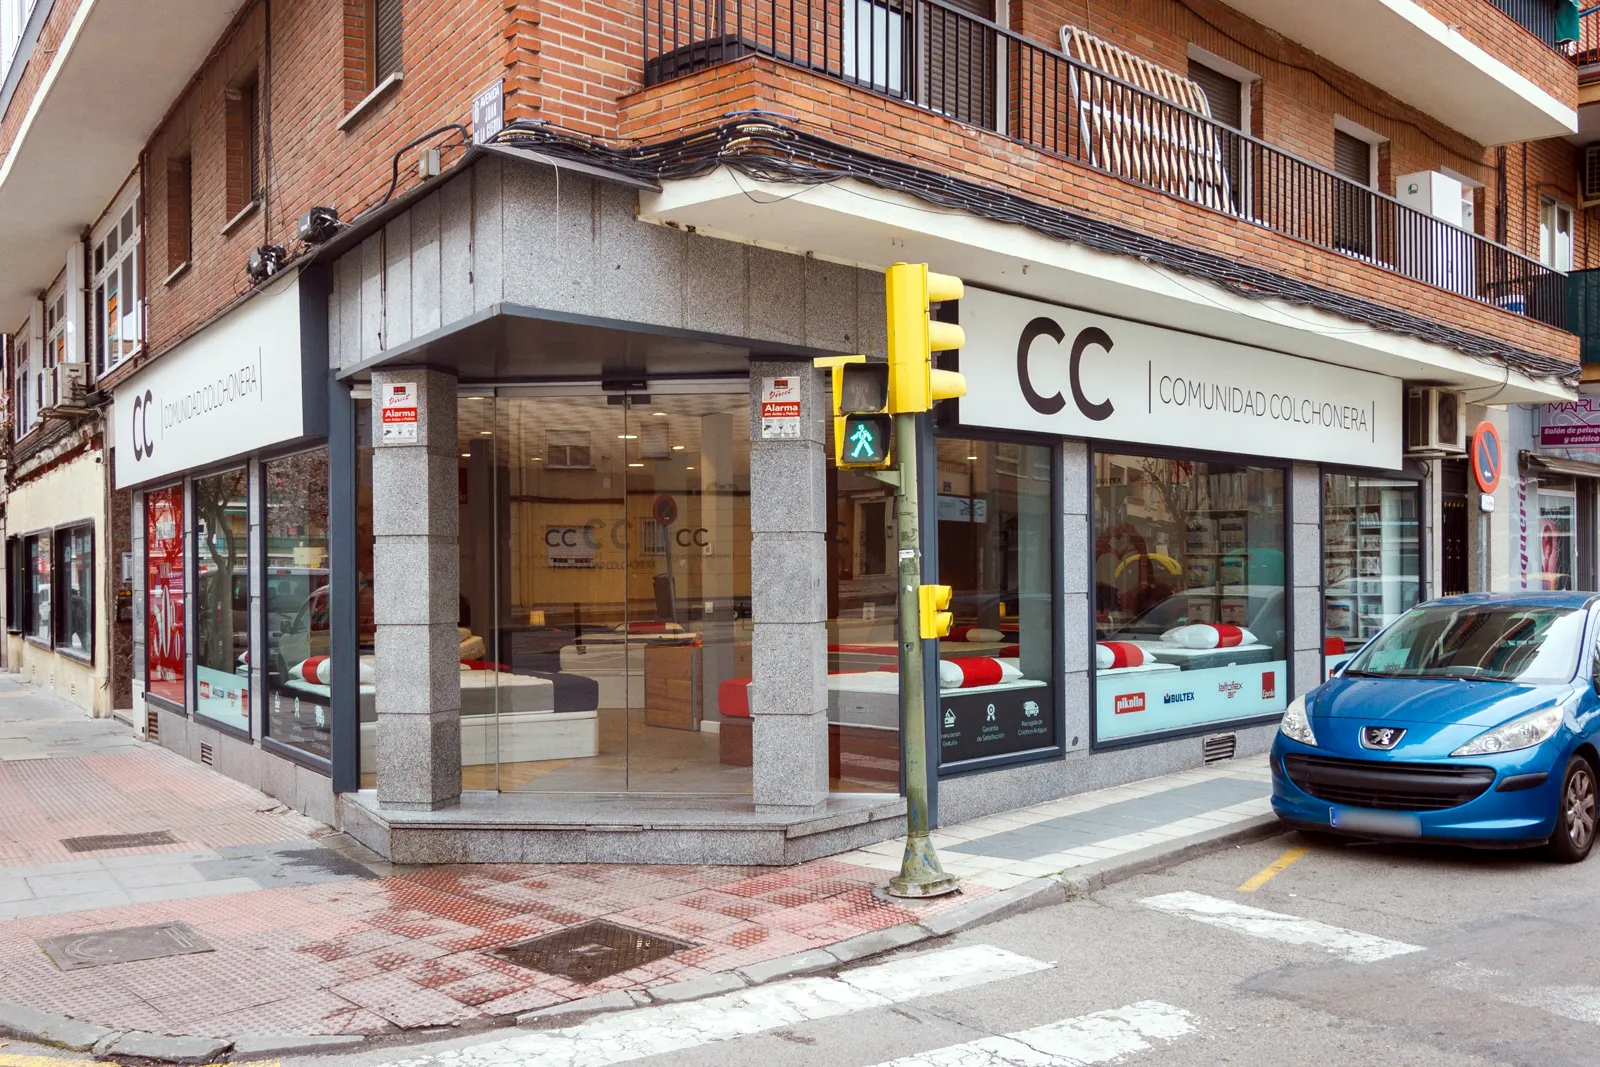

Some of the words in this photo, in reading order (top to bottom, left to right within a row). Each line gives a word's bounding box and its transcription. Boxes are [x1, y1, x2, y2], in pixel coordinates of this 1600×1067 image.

[480, 85, 500, 109] AVENIDA
[484, 101, 497, 123] JUAN
[1017, 316, 1115, 421] CC
[1159, 375, 1267, 418] COMUNIDAD
[1269, 392, 1368, 433] COLCHONERA
[132, 389, 154, 462] CC
[163, 390, 201, 429] COMUNIDAD
[202, 364, 258, 414] COLCHONERA
[384, 409, 415, 418] Alarma
[764, 403, 798, 412] Alarma
[1548, 398, 1600, 414] MARL
[1544, 427, 1565, 435] Salón
[1563, 436, 1570, 444] y
[1570, 434, 1600, 443] estética
[545, 528, 577, 548] CC
[676, 528, 709, 548] CC
[1171, 692, 1195, 703] BULTEX
[1227, 690, 1237, 699] air
[1117, 695, 1144, 712] pikolin
